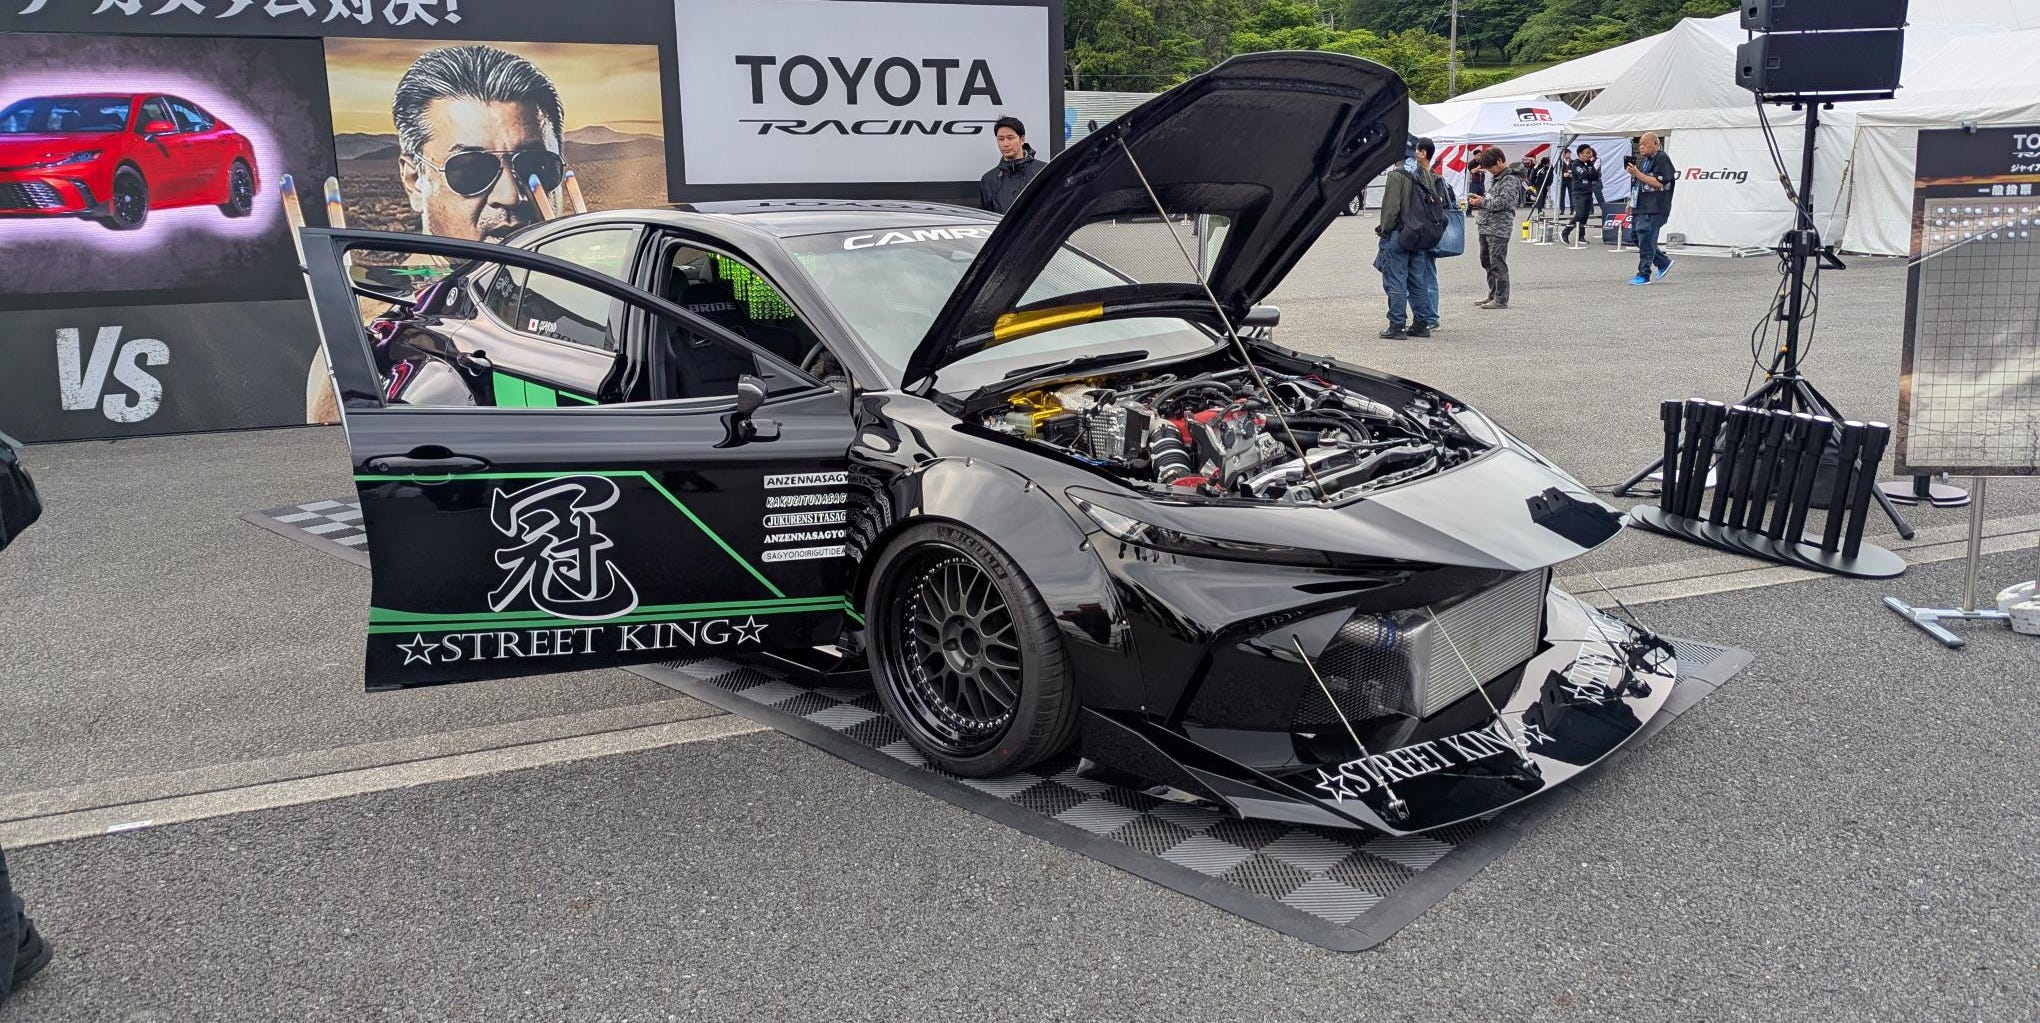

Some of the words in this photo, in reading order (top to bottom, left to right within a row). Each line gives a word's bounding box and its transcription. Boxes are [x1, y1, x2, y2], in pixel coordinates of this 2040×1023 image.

[735, 55, 1003, 106] TOYOTA
[739, 119, 998, 135] RACING
[1685, 167, 1749, 184] Racing
[687, 302, 736, 313] BRIDE
[765, 492, 848, 508] KAKUZITUNASAG
[763, 529, 847, 544] ANZENNASAGYO
[487, 474, 639, 621] 冠
[440, 626, 604, 662] STREET
[616, 618, 730, 652] KING
[1338, 740, 1456, 793] STREET
